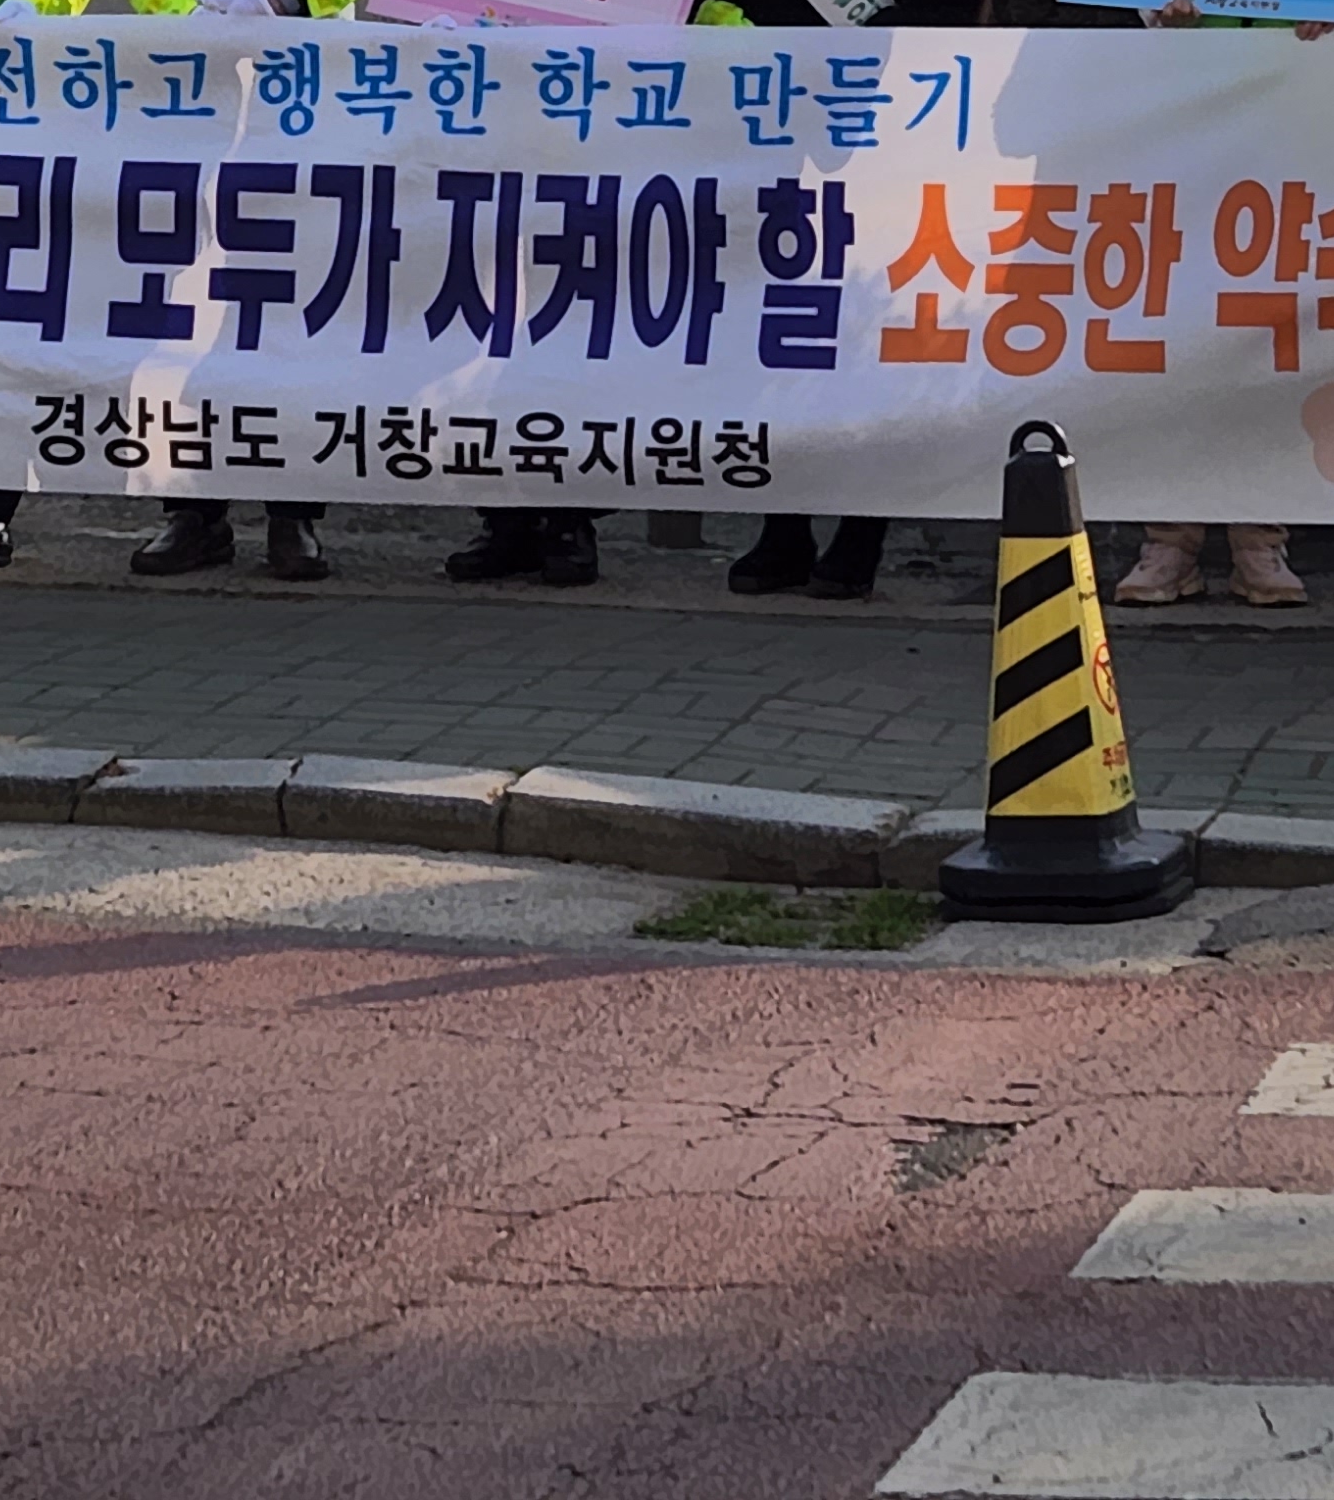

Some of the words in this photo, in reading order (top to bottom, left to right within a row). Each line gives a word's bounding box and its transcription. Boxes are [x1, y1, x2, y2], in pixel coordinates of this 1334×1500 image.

[251, 41, 501, 136] 행복한
[530, 44, 692, 142] 학교
[728, 52, 973, 152] 만들기
[106, 159, 403, 354] 모두가
[423, 170, 727, 365] 지켜야
[756, 177, 855, 370] 할
[878, 181, 1184, 377] 소중한
[30, 394, 287, 471] 경상남도
[311, 404, 773, 489] 거창교육지원청
